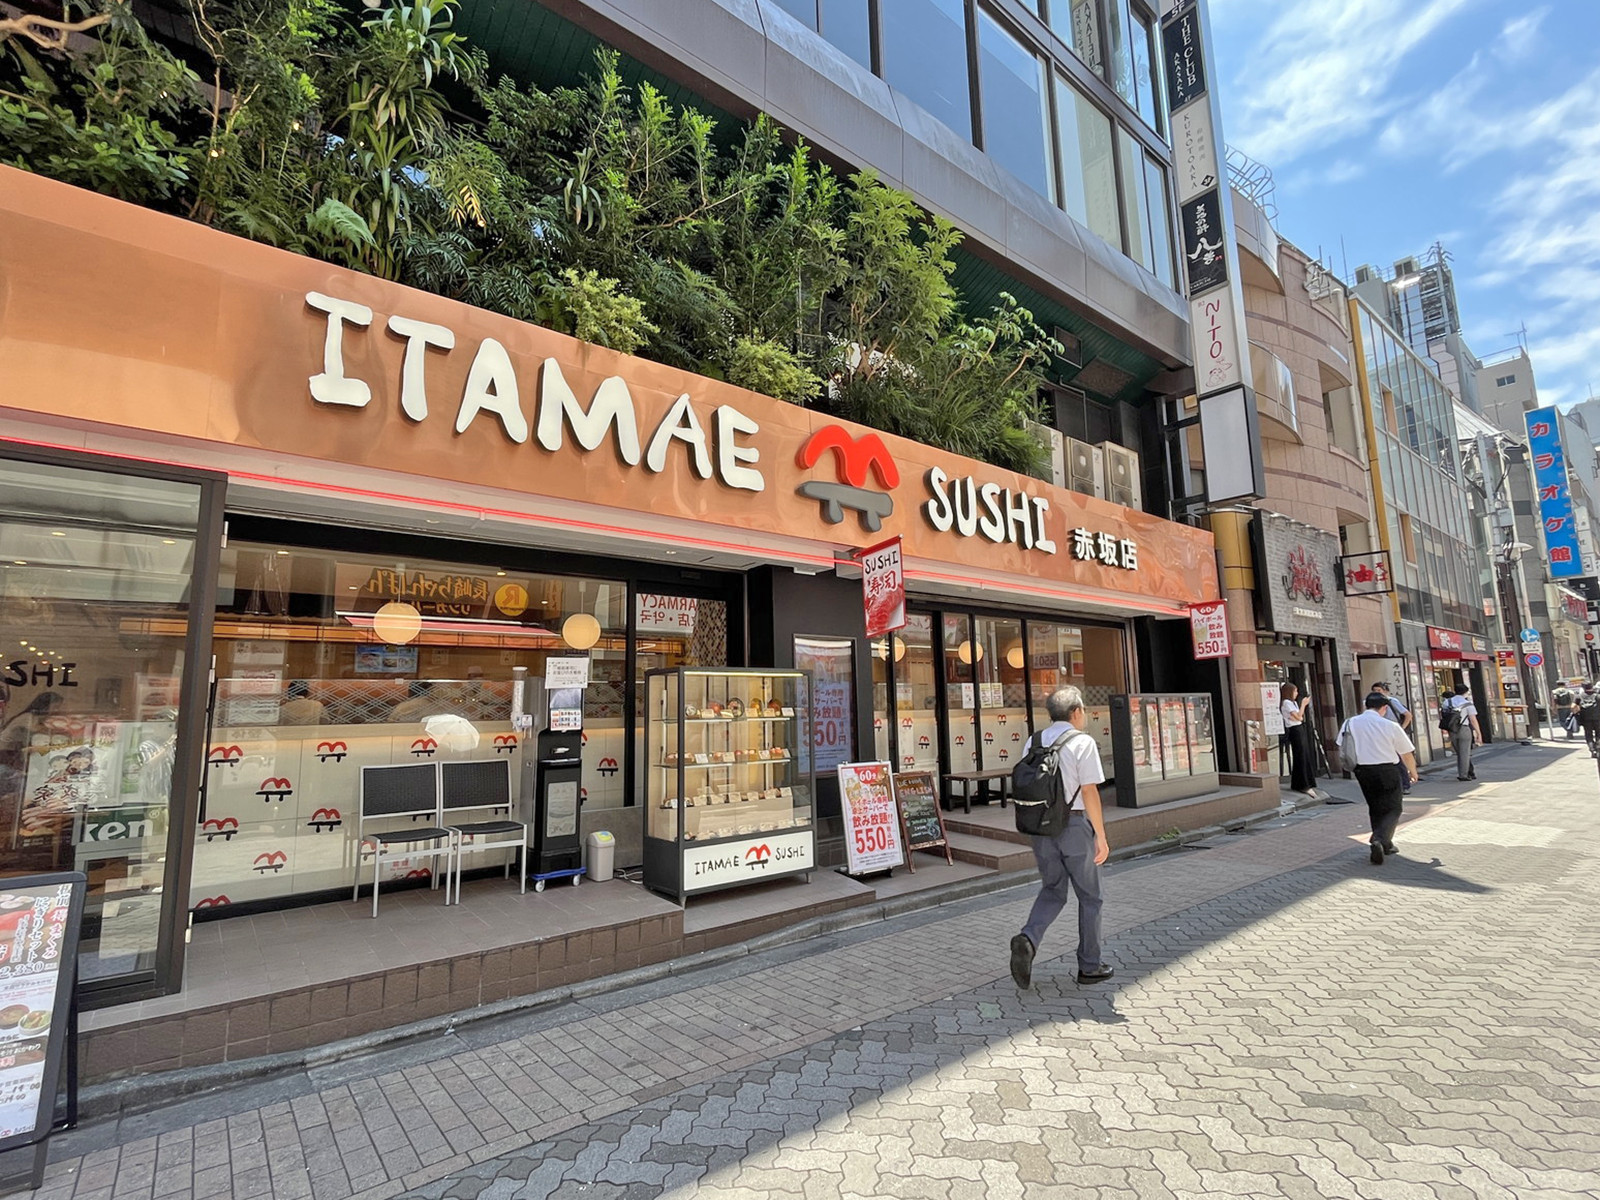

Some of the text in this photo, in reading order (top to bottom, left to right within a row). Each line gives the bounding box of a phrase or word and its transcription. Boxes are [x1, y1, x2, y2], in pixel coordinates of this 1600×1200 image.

[1181, 15, 1197, 87] THE CLUB
[1173, 52, 1185, 99] AKASAKA
[1183, 113, 1198, 190] KUROTOAKA
[1205, 299, 1222, 359] NITO
[304, 290, 1057, 556] ITAMAE SUSHI
[1531, 422, 1572, 564] カラオケ館
[864, 550, 899, 575] SUSHI
[1071, 527, 1139, 571] 赤坂店
[867, 570, 897, 597] 寿司
[1198, 640, 1219, 655] 550
[694, 845, 805, 876] ITAMAE SUSHI
[854, 826, 887, 854] 550
